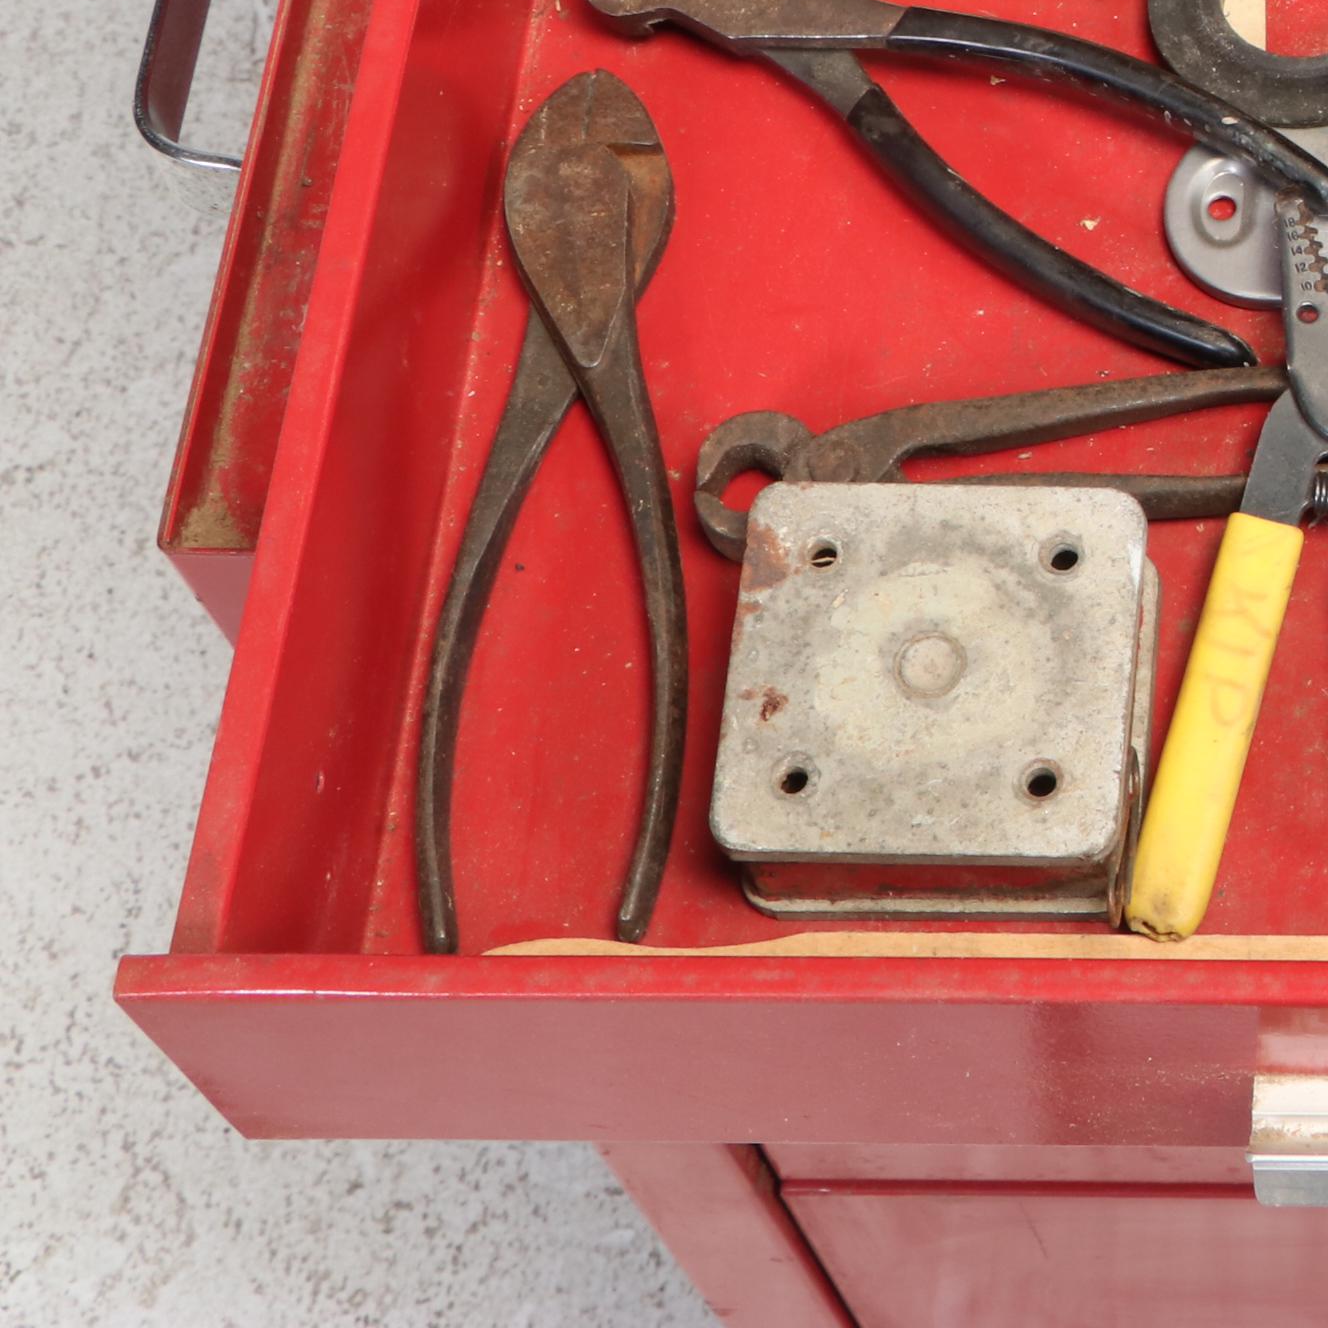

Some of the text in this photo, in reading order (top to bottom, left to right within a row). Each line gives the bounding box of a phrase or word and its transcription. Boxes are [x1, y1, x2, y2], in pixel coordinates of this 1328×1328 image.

[1283, 217, 1296, 228] 18
[1287, 231, 1299, 241] 16
[1291, 245, 1303, 256] 14
[1295, 262, 1308, 273] 12
[1301, 280, 1313, 291] 10
